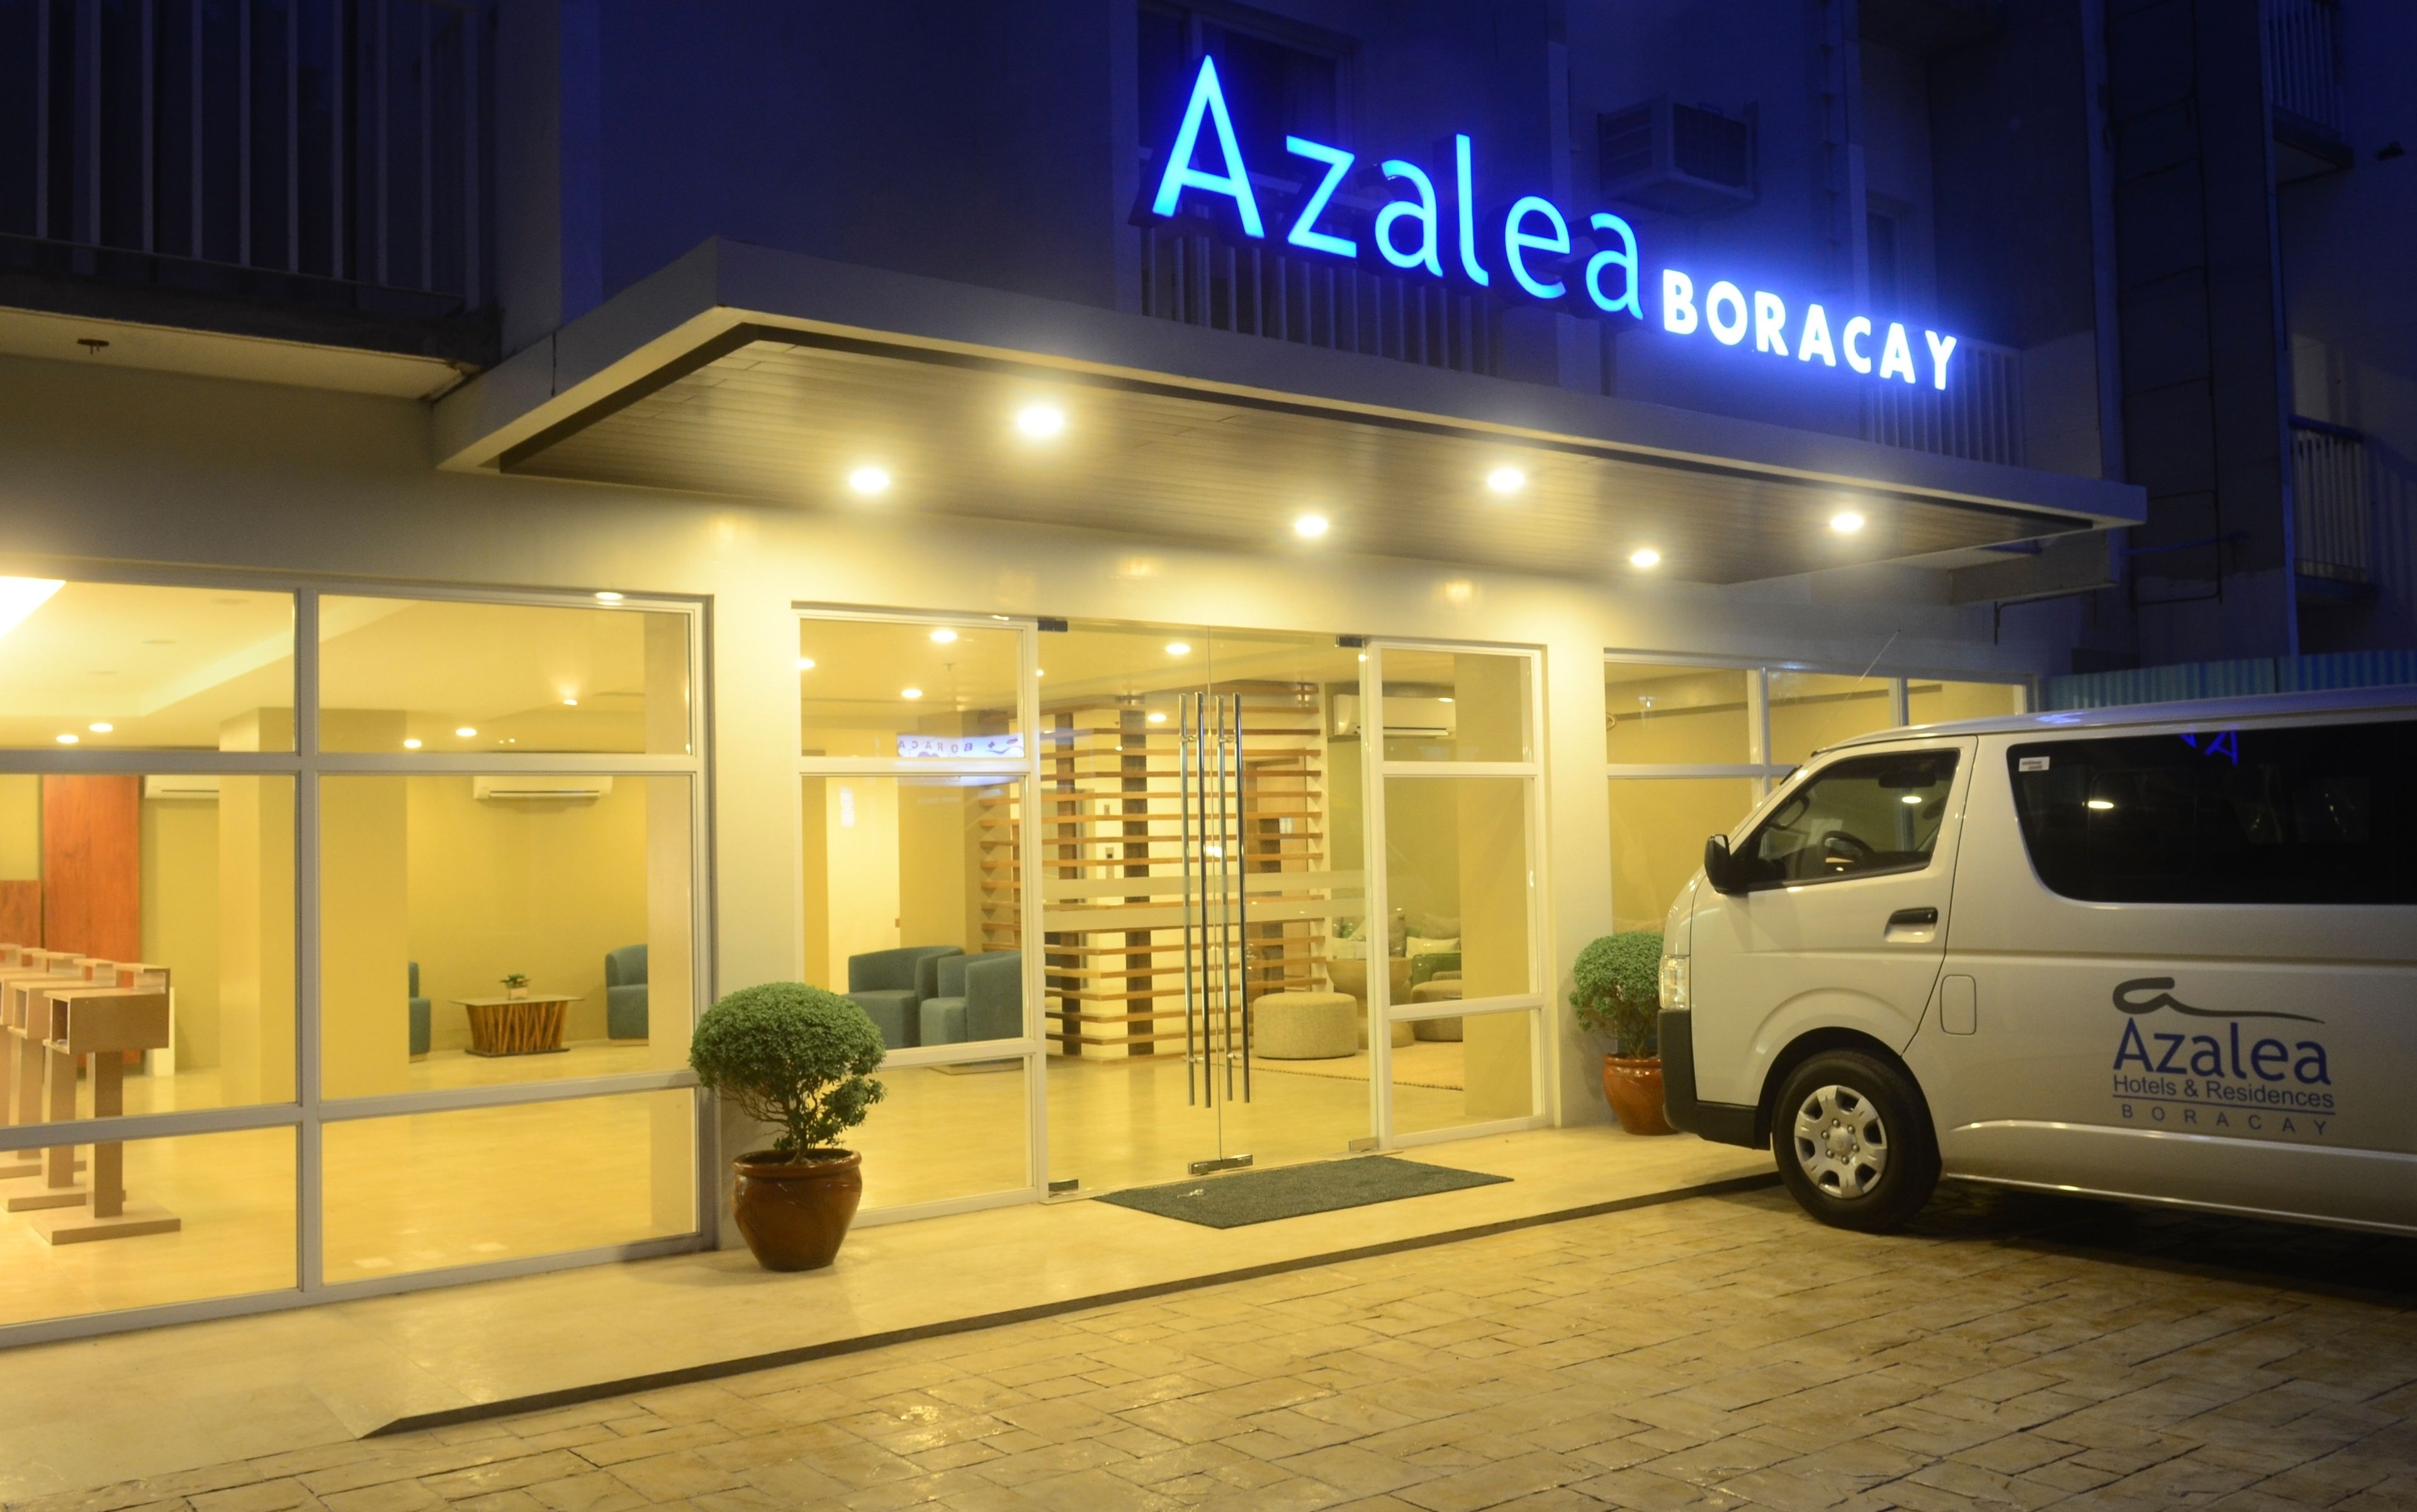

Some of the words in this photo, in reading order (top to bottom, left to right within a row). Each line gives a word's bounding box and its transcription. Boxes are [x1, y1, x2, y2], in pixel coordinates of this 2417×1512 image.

[1152, 55, 1643, 319] Azalea
[1662, 269, 1958, 390] BORACAY
[2113, 1017, 2331, 1085] Azalea
[2114, 1075, 2177, 1096] Hotels
[2184, 1079, 2199, 1098] &
[2206, 1081, 2334, 1109] Residences
[2122, 1104, 2327, 1135] BORACAY
